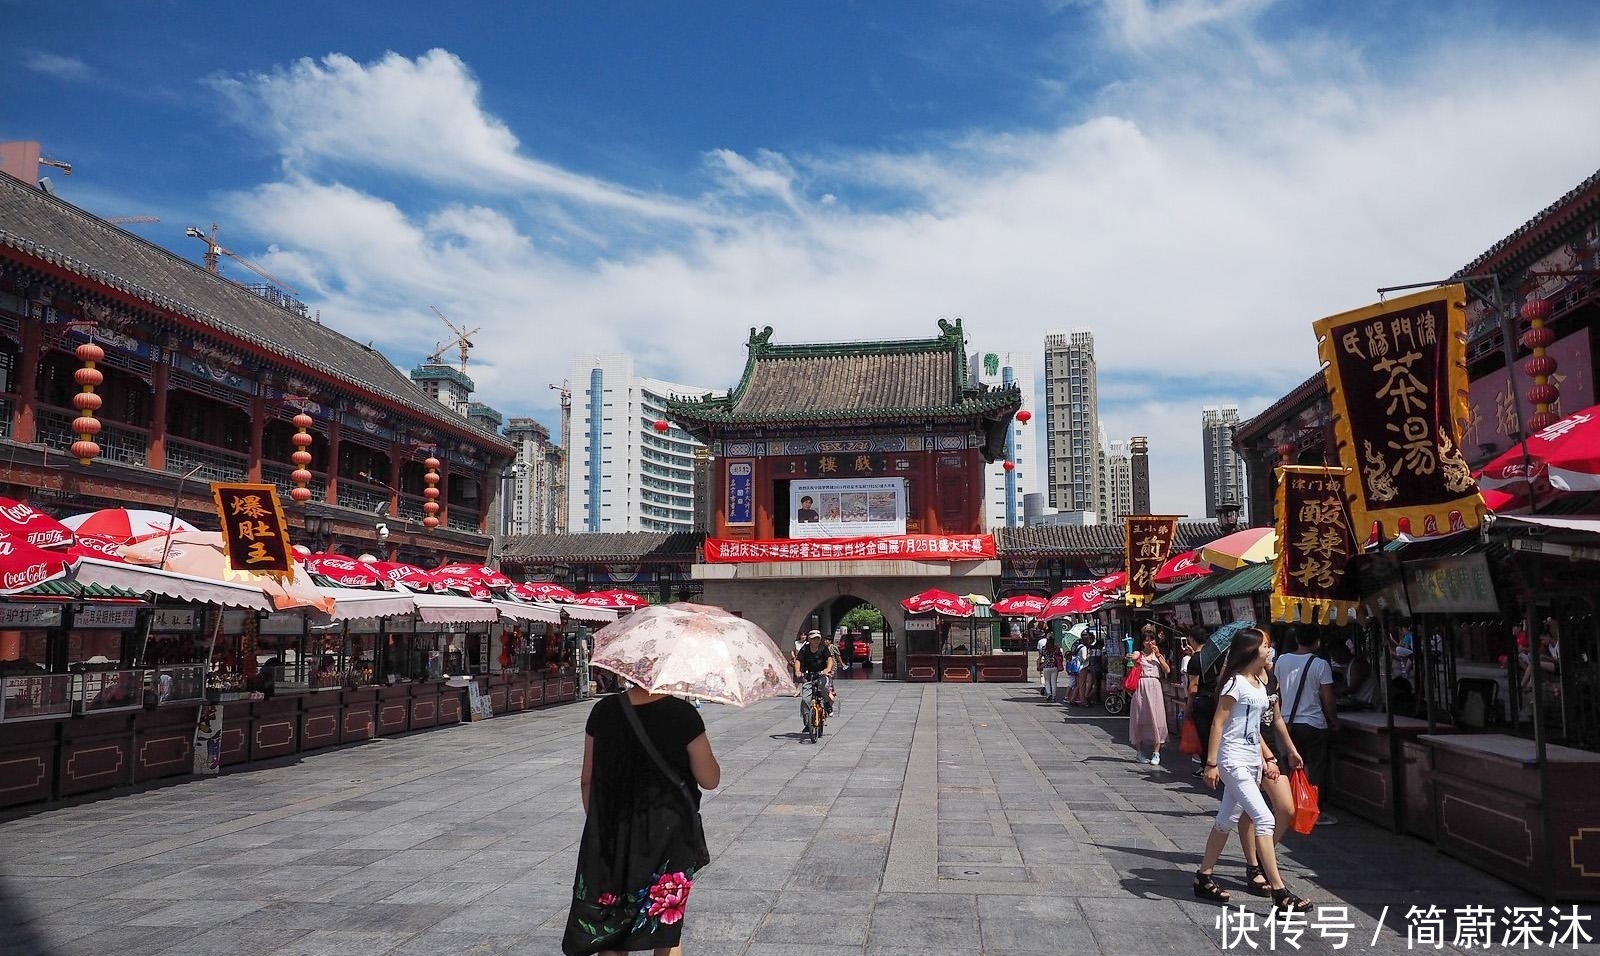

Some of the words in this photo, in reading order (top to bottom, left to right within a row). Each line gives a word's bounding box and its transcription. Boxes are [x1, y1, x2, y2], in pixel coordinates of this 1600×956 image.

[27, 529, 64, 545] 可口可乐
[230, 495, 276, 564] 爆肚王
[1289, 495, 1347, 589] 酸辣粉
[4, 562, 47, 589] Coca-Cola
